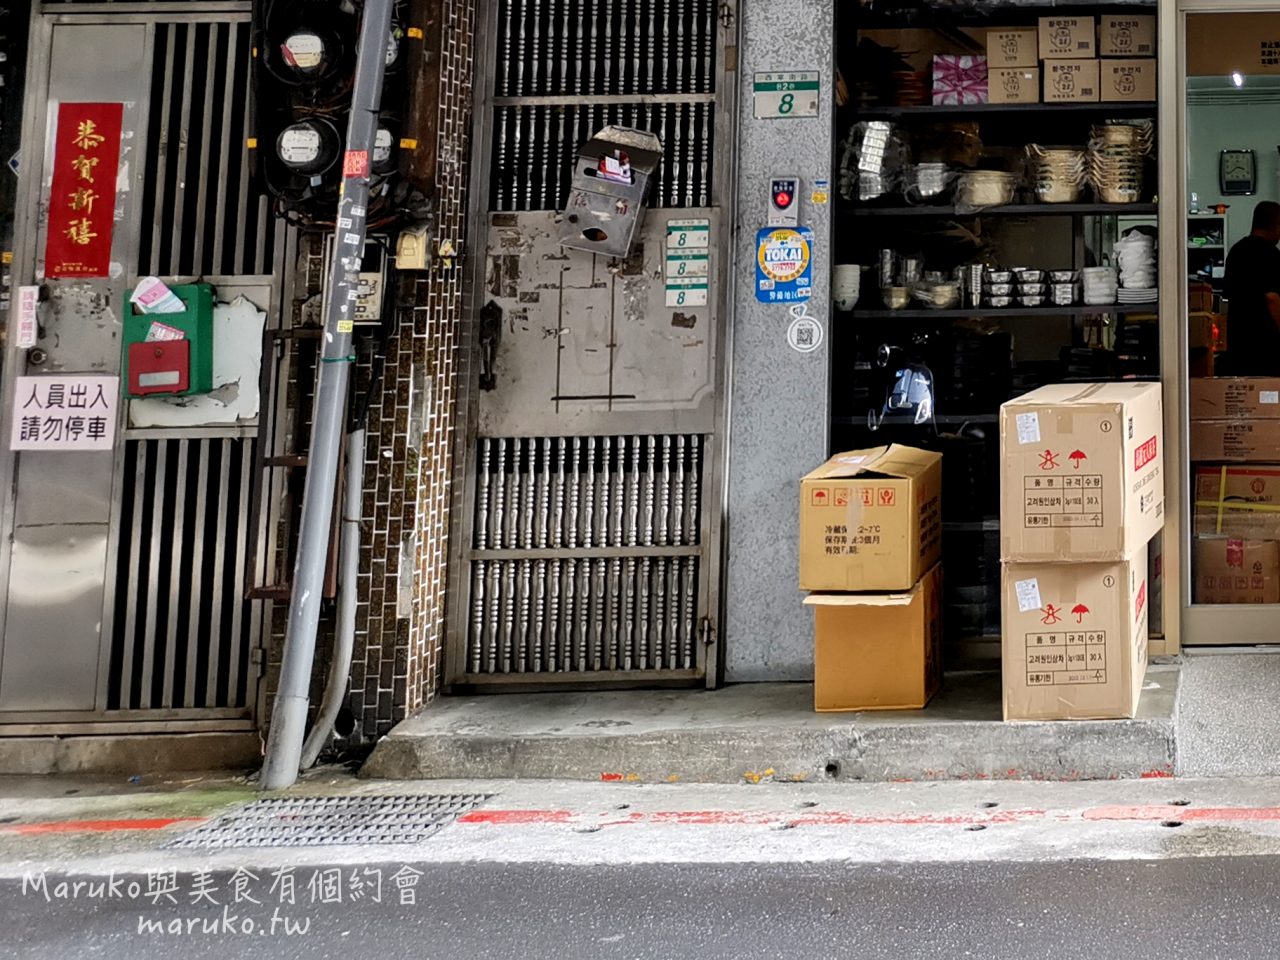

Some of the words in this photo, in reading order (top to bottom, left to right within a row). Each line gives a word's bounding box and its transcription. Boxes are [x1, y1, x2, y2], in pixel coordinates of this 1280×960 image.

[778, 93, 795, 115] 8
[678, 232, 687, 246] 8
[765, 248, 802, 261] TOKAI
[677, 262, 686, 276] 8
[677, 291, 685, 305] 8
[23, 384, 109, 409] 人員出入
[20, 415, 107, 441] 請勿停車
